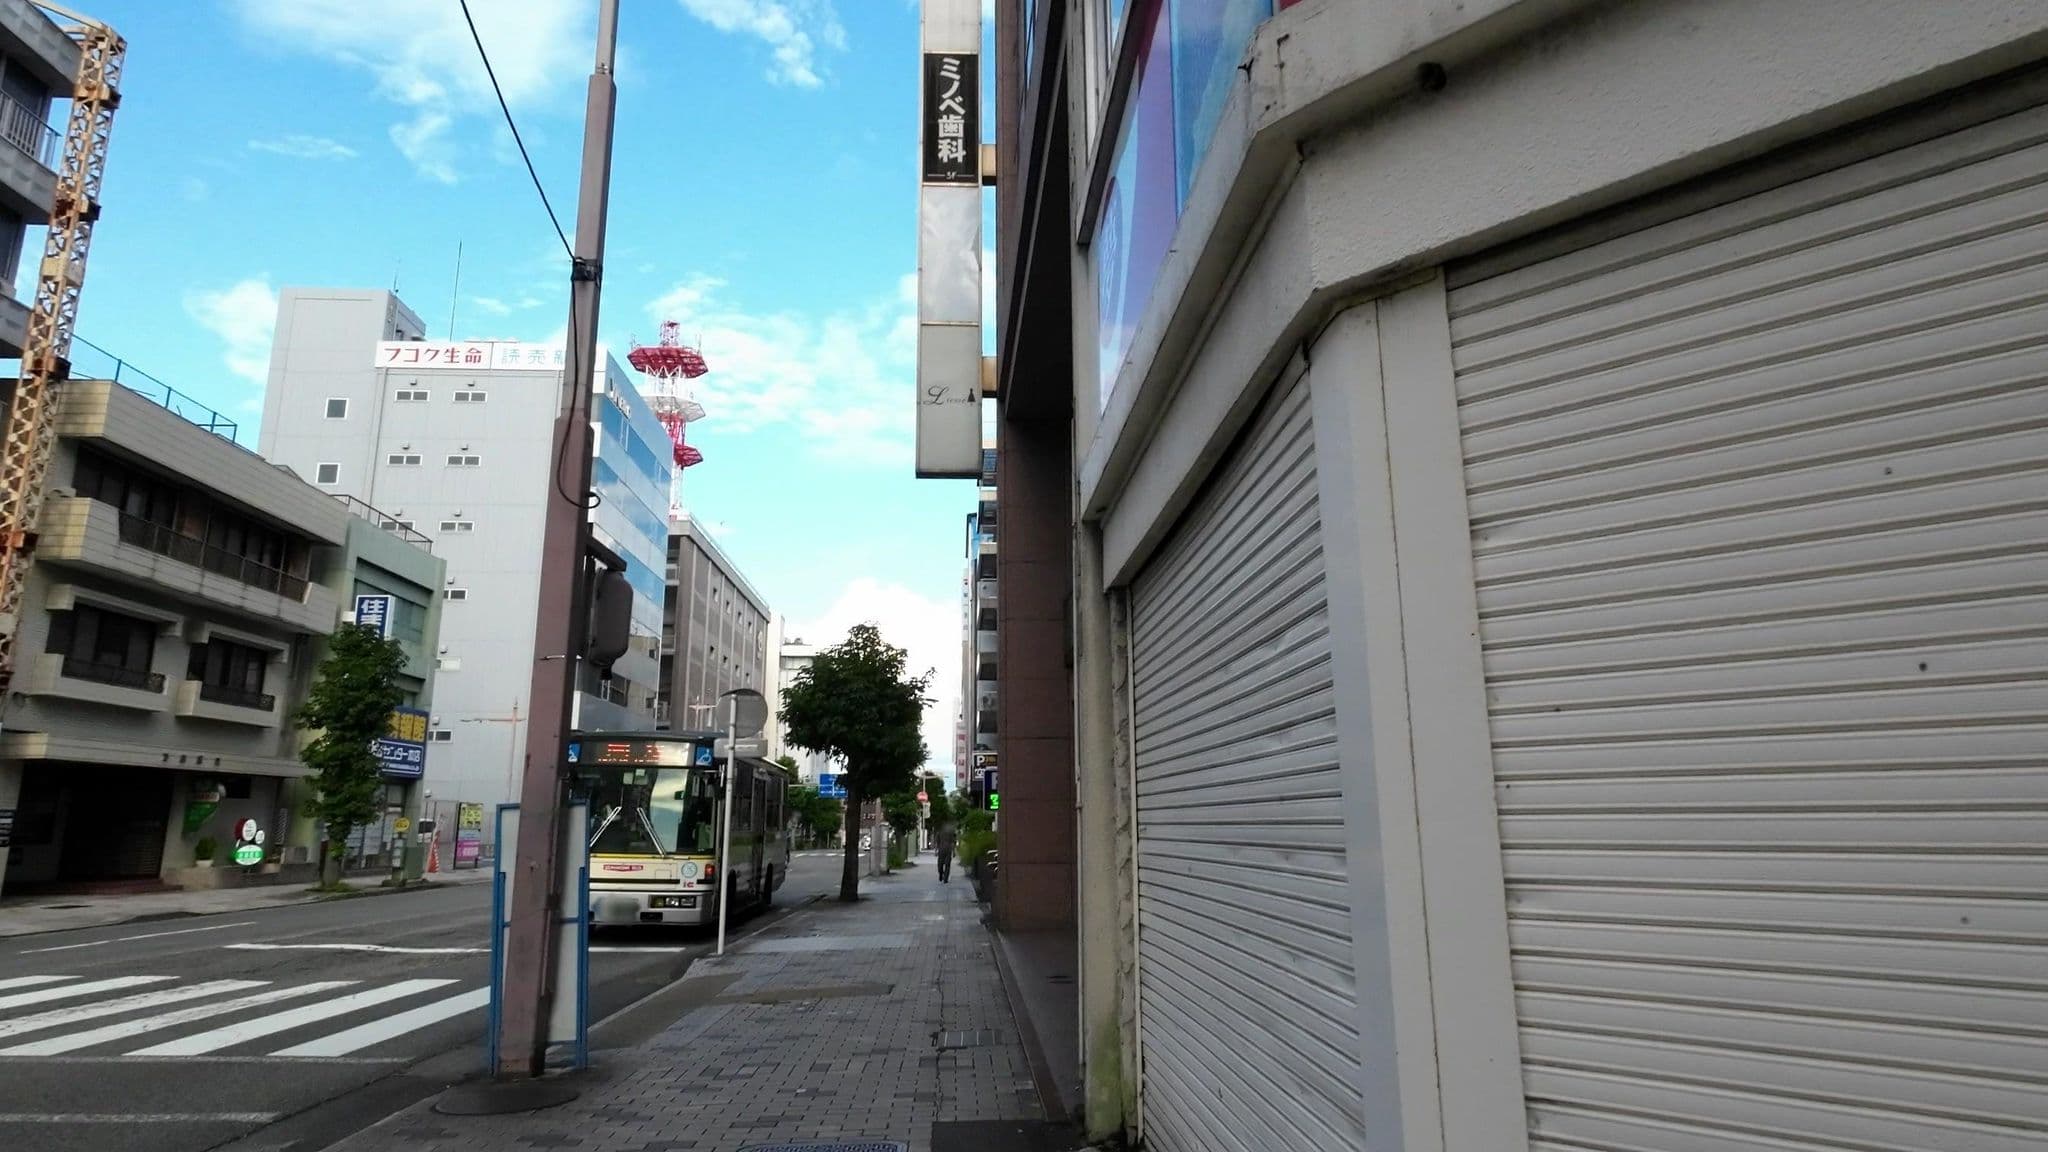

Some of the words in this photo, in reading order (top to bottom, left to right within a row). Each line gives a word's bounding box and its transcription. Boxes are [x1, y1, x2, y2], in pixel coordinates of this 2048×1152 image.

[937, 57, 967, 163] ミノベ歯科
[384, 347, 483, 364] フコク生命
